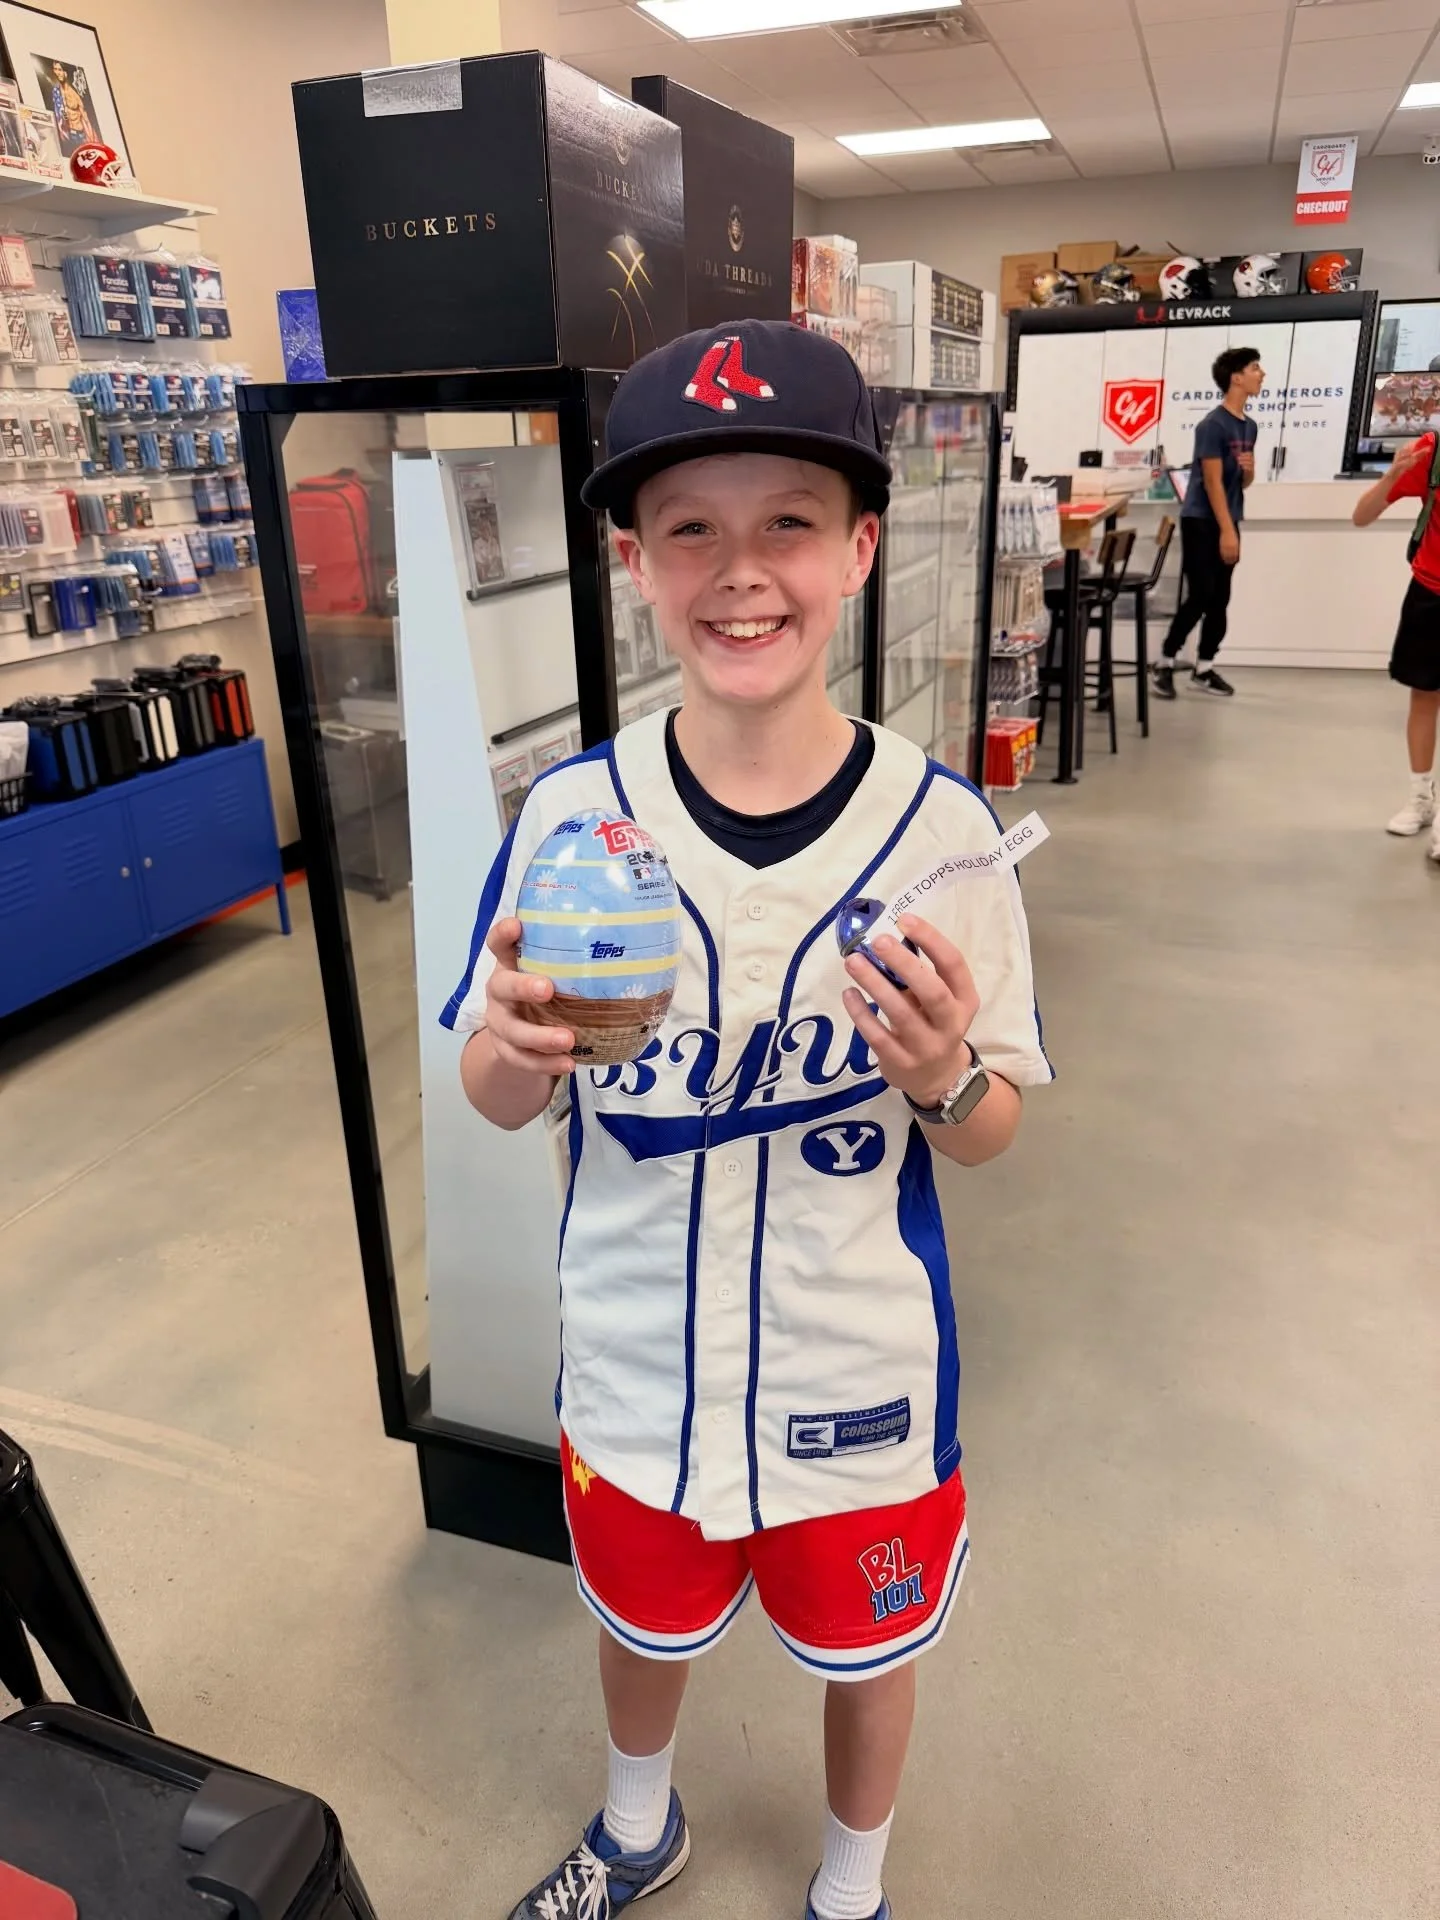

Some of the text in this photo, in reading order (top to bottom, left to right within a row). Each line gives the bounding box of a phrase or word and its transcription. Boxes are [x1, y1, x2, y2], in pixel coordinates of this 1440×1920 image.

[1296, 200, 1348, 215] CHECKOUT
[366, 212, 497, 241] BUCKETS
[1168, 305, 1231, 321] LEVRACK
[1277, 387, 1344, 398] HEROES
[1258, 402, 1296, 412] SHOP
[1293, 420, 1327, 428] MORE
[891, 891, 915, 919] FREE
[913, 862, 954, 895] TOPPS
[953, 846, 1003, 870] HOLIDAY
[1004, 826, 1034, 852] EGG
[816, 1126, 877, 1170] Y
[840, 1412, 908, 1439] colosseum
[793, 1449, 812, 1457] SINCE
[858, 1537, 923, 1593] BL
[871, 1573, 926, 1622] 101
